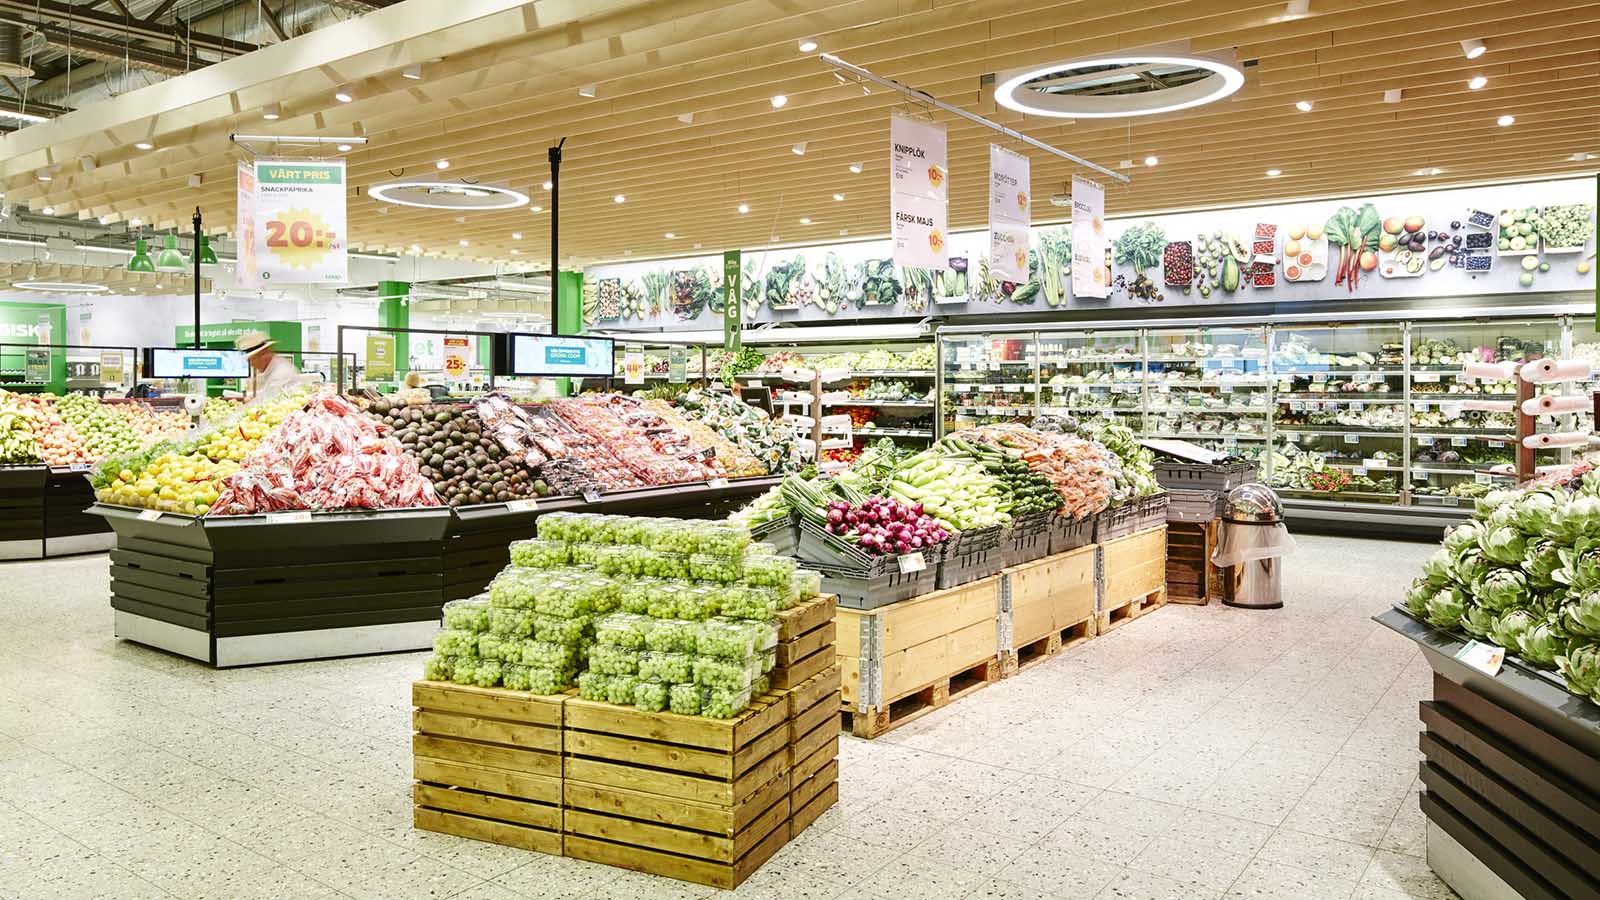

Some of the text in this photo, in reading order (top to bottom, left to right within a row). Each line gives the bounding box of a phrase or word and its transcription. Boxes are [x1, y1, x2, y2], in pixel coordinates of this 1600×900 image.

[894, 143, 926, 159] KNIPPLÖK
[269, 168, 331, 180] VÅRT PRIS
[916, 215, 934, 227] MAJS
